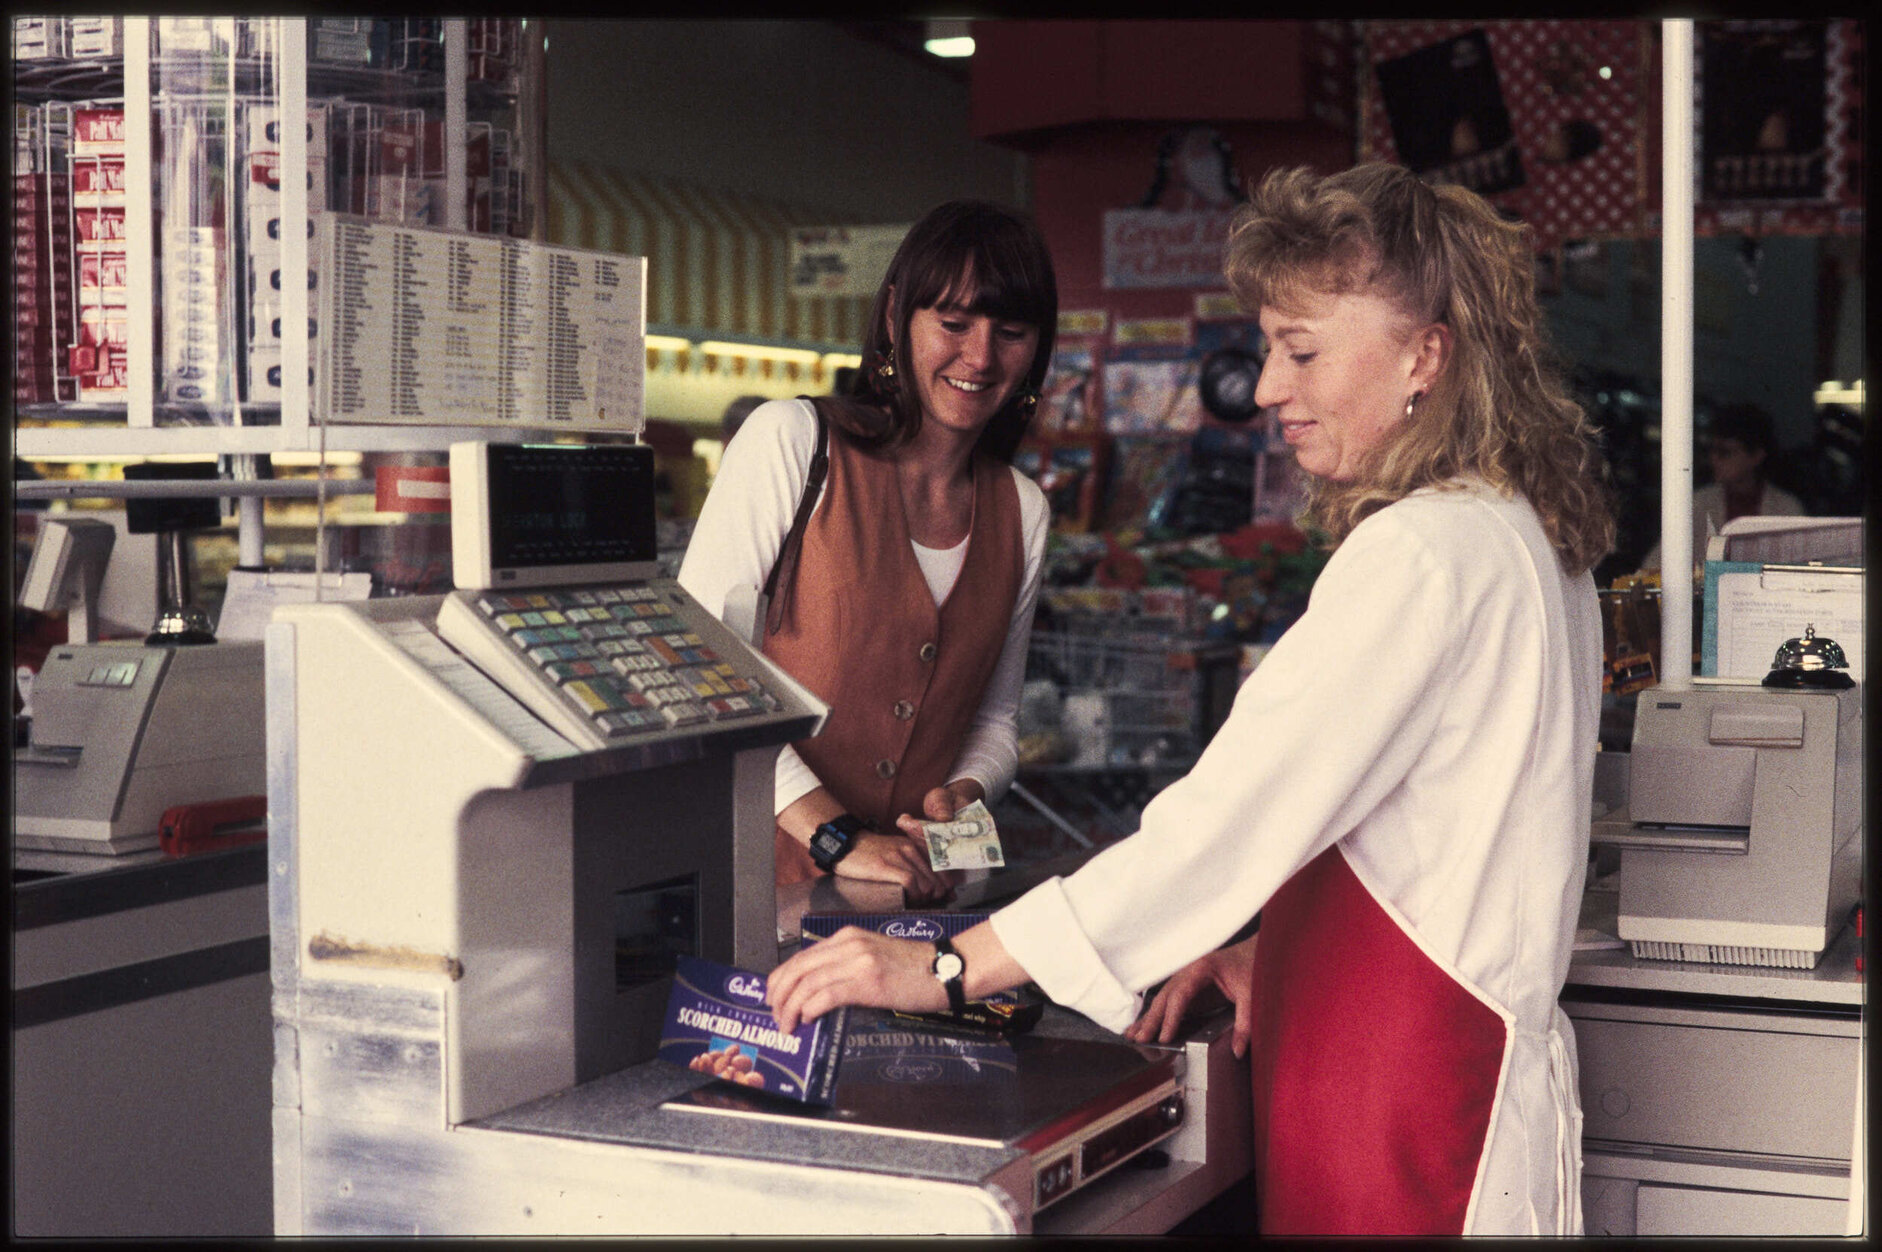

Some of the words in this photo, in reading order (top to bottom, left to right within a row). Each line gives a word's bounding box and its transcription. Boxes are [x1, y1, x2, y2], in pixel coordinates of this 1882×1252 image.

[885, 920, 935, 939] Cadbury
[728, 976, 764, 1003] Cadbury
[677, 1007, 742, 1039] SCORCHED
[740, 1024, 802, 1055] ALMONDS
